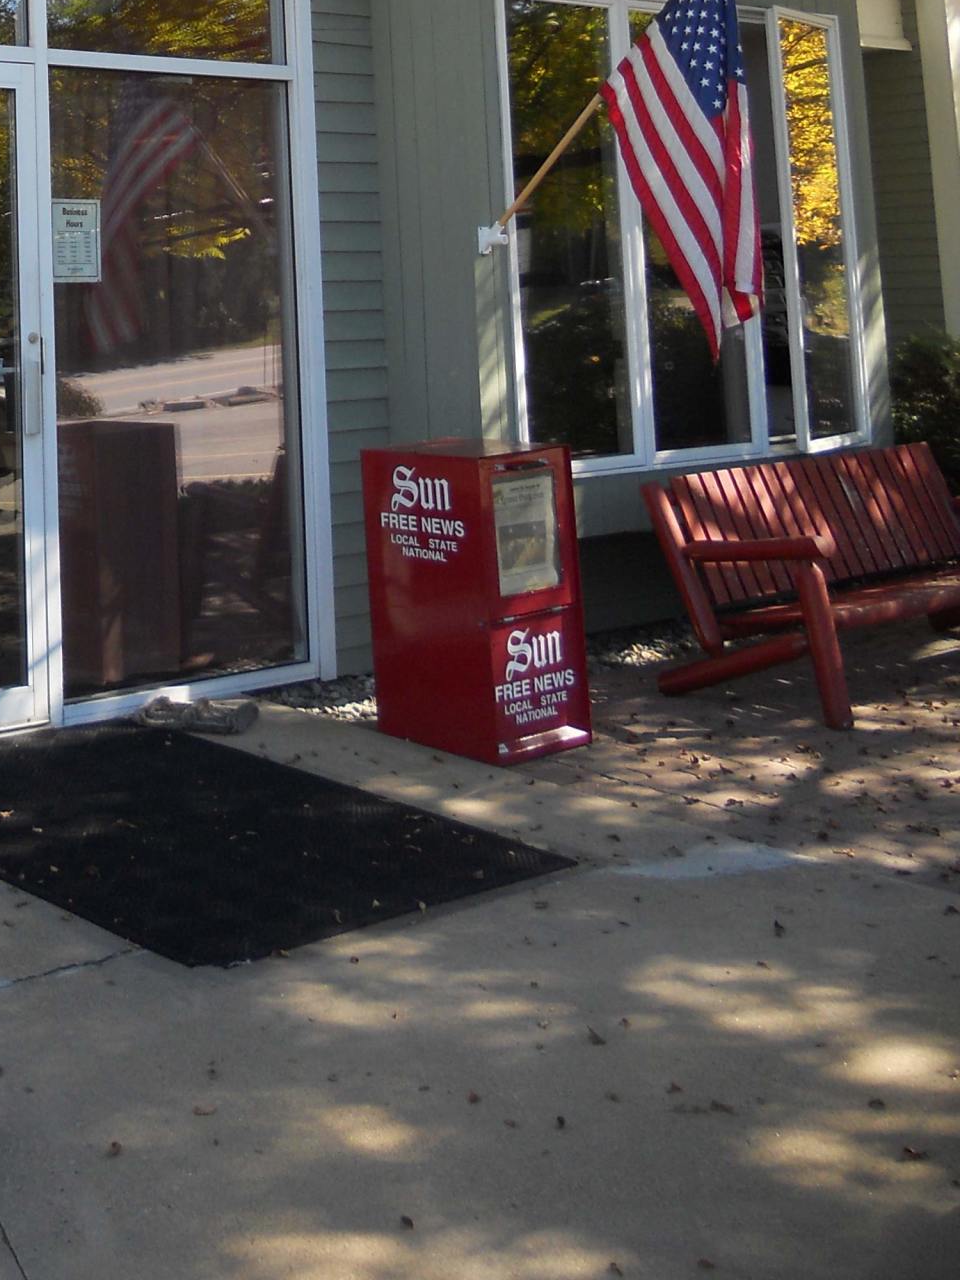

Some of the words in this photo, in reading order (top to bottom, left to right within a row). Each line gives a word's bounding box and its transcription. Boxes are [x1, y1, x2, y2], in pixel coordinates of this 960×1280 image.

[391, 465, 451, 511] Sun
[380, 512, 417, 531] FREE
[421, 517, 465, 537] NEWS
[390, 533, 420, 546] LOCAL
[428, 538, 458, 552] STATE
[402, 546, 447, 562] NATIONAL
[506, 627, 562, 681] Sun
[495, 679, 531, 703] FREE
[534, 669, 575, 693] NEWS
[505, 701, 532, 715] LOCAL
[541, 690, 568, 705] STATE
[516, 706, 558, 724] NATIONAL
